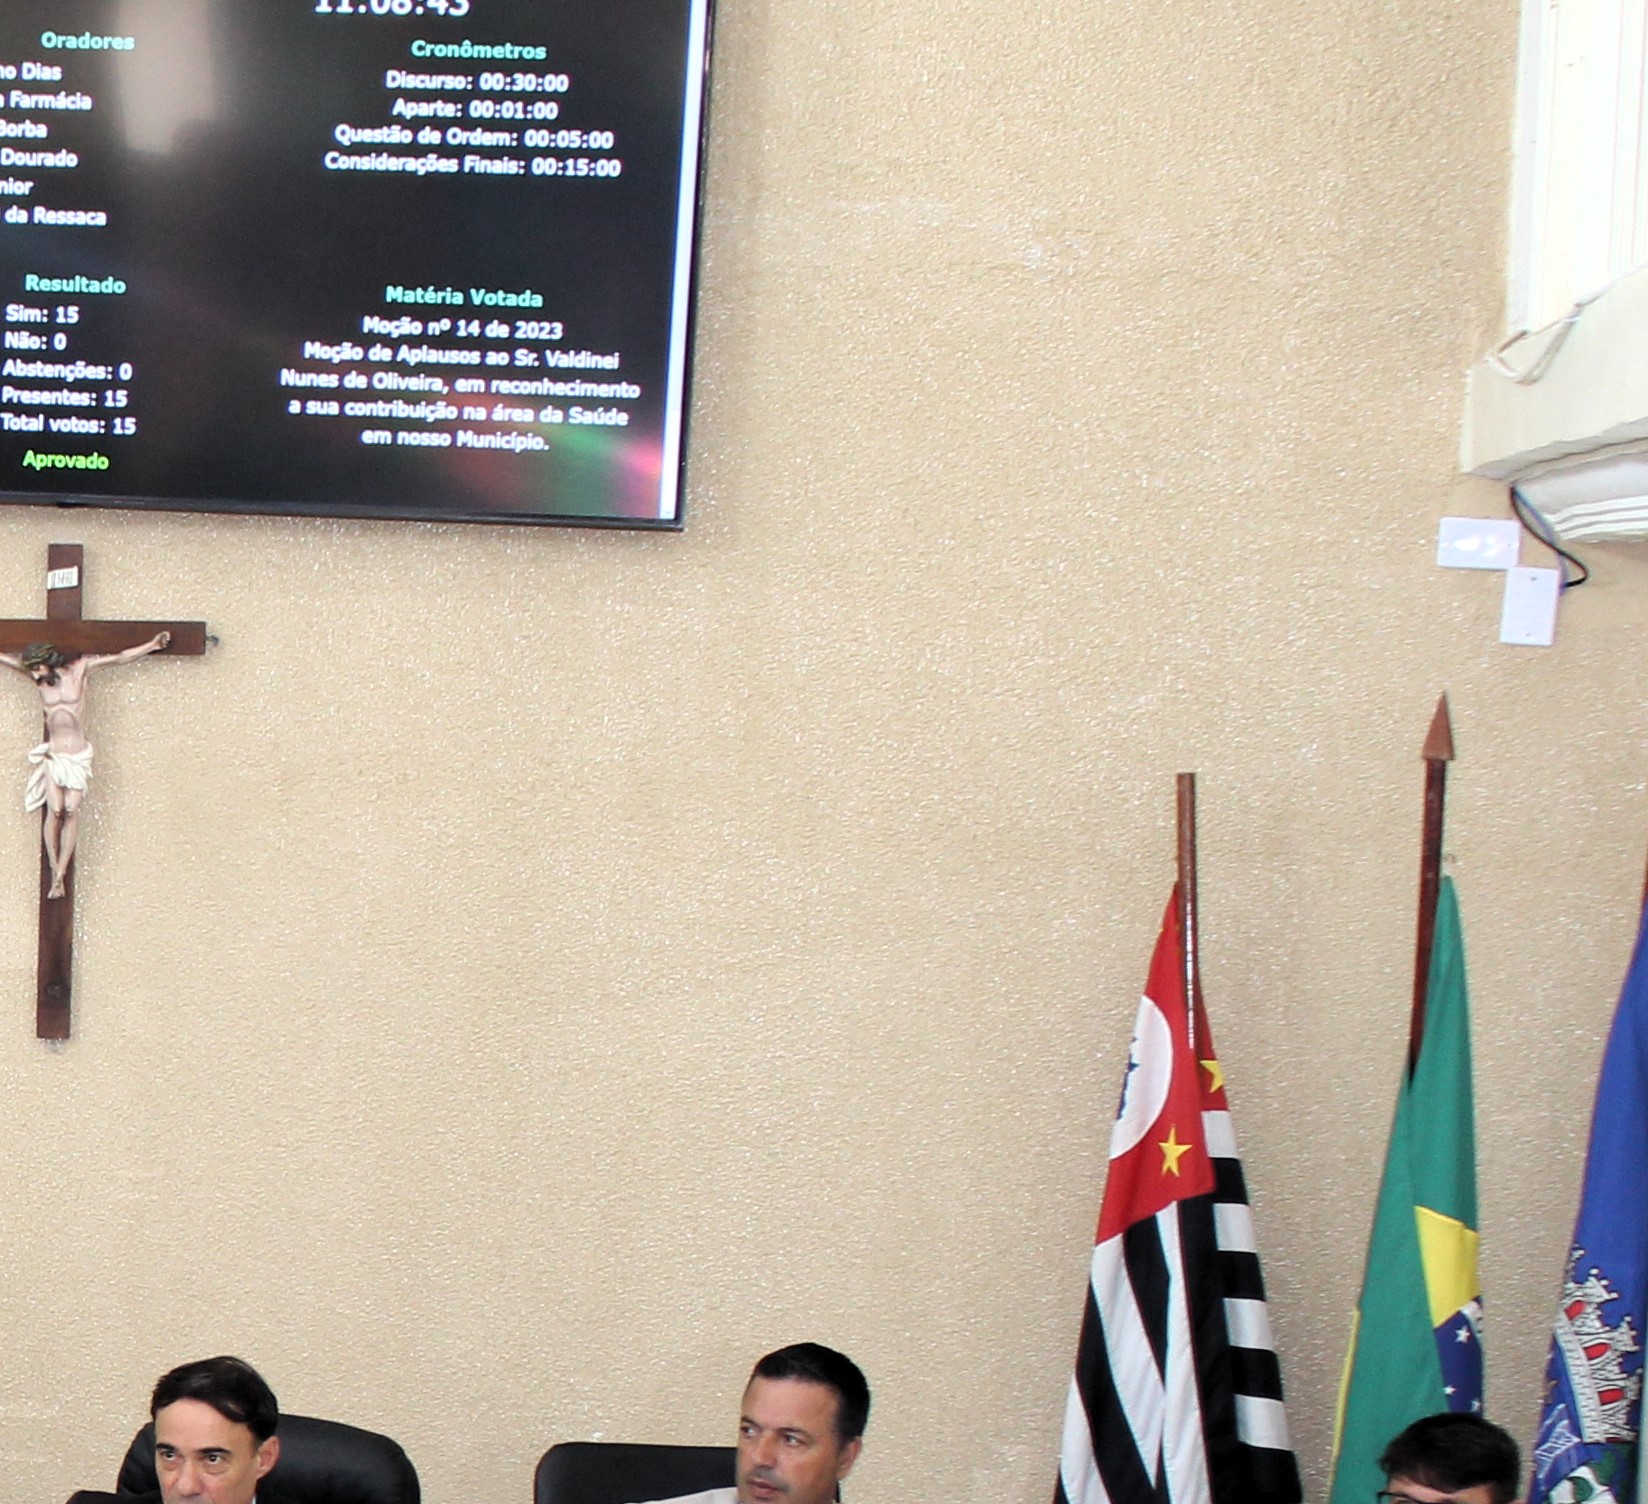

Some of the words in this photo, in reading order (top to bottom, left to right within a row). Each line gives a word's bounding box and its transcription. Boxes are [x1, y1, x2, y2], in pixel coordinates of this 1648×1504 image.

[42, 32, 135, 50] Oradores
[412, 39, 546, 59] Cronômetros
[21, 61, 62, 81] Dias
[385, 69, 472, 90] Discurso:
[478, 72, 569, 93] 00:30:00
[9, 89, 92, 111] Farmácia
[392, 97, 462, 120] Aparte:
[469, 99, 558, 120] 00:01:00
[334, 124, 413, 146] Questão
[416, 125, 442, 144] de
[445, 127, 517, 147] Ordem:
[523, 129, 614, 150] 00:05:00
[0, 147, 78, 168] Dourado
[324, 150, 459, 176] Considerações
[463, 155, 525, 175] Finais:
[531, 156, 621, 178] 00:15:00
[4, 205, 28, 224] da
[32, 205, 106, 226] Ressaca
[25, 274, 126, 293] Resultado
[386, 285, 463, 305] Matéria
[470, 288, 543, 307] Votada
[5, 303, 48, 323] Sim:
[56, 305, 79, 324] 15
[362, 315, 423, 339] Moção
[456, 319, 481, 337] 14
[484, 319, 510, 339] de
[514, 320, 563, 340] 2023
[4, 330, 47, 350] Não:
[53, 332, 66, 351] 0
[303, 341, 364, 364] Moção
[367, 343, 393, 362] de
[396, 344, 481, 367] Aplausos
[484, 351, 510, 366] ao
[513, 348, 539, 367] Sr.
[545, 350, 619, 370] Valdinei
[2, 359, 112, 383] Abstenções:
[118, 362, 132, 381] 0
[280, 368, 339, 389] Nunes
[342, 370, 368, 389] de
[371, 371, 449, 395] Oliveira,
[454, 378, 485, 393] em
[490, 377, 641, 399] reconhecimento
[1, 385, 96, 407] Presentes:
[104, 389, 128, 408] 15
[0, 412, 44, 432] Total
[48, 415, 105, 434] votos:
[113, 416, 136, 436] 15
[289, 400, 300, 413] a
[306, 400, 339, 415] sua
[344, 400, 458, 422] contribuição
[463, 406, 487, 421] na
[491, 403, 534, 422] área
[539, 406, 563, 424] da
[569, 406, 628, 426] Saúde
[360, 429, 392, 445] em
[396, 431, 452, 447] nosso
[456, 427, 550, 452] Município.
[23, 450, 109, 470] Aprovado
